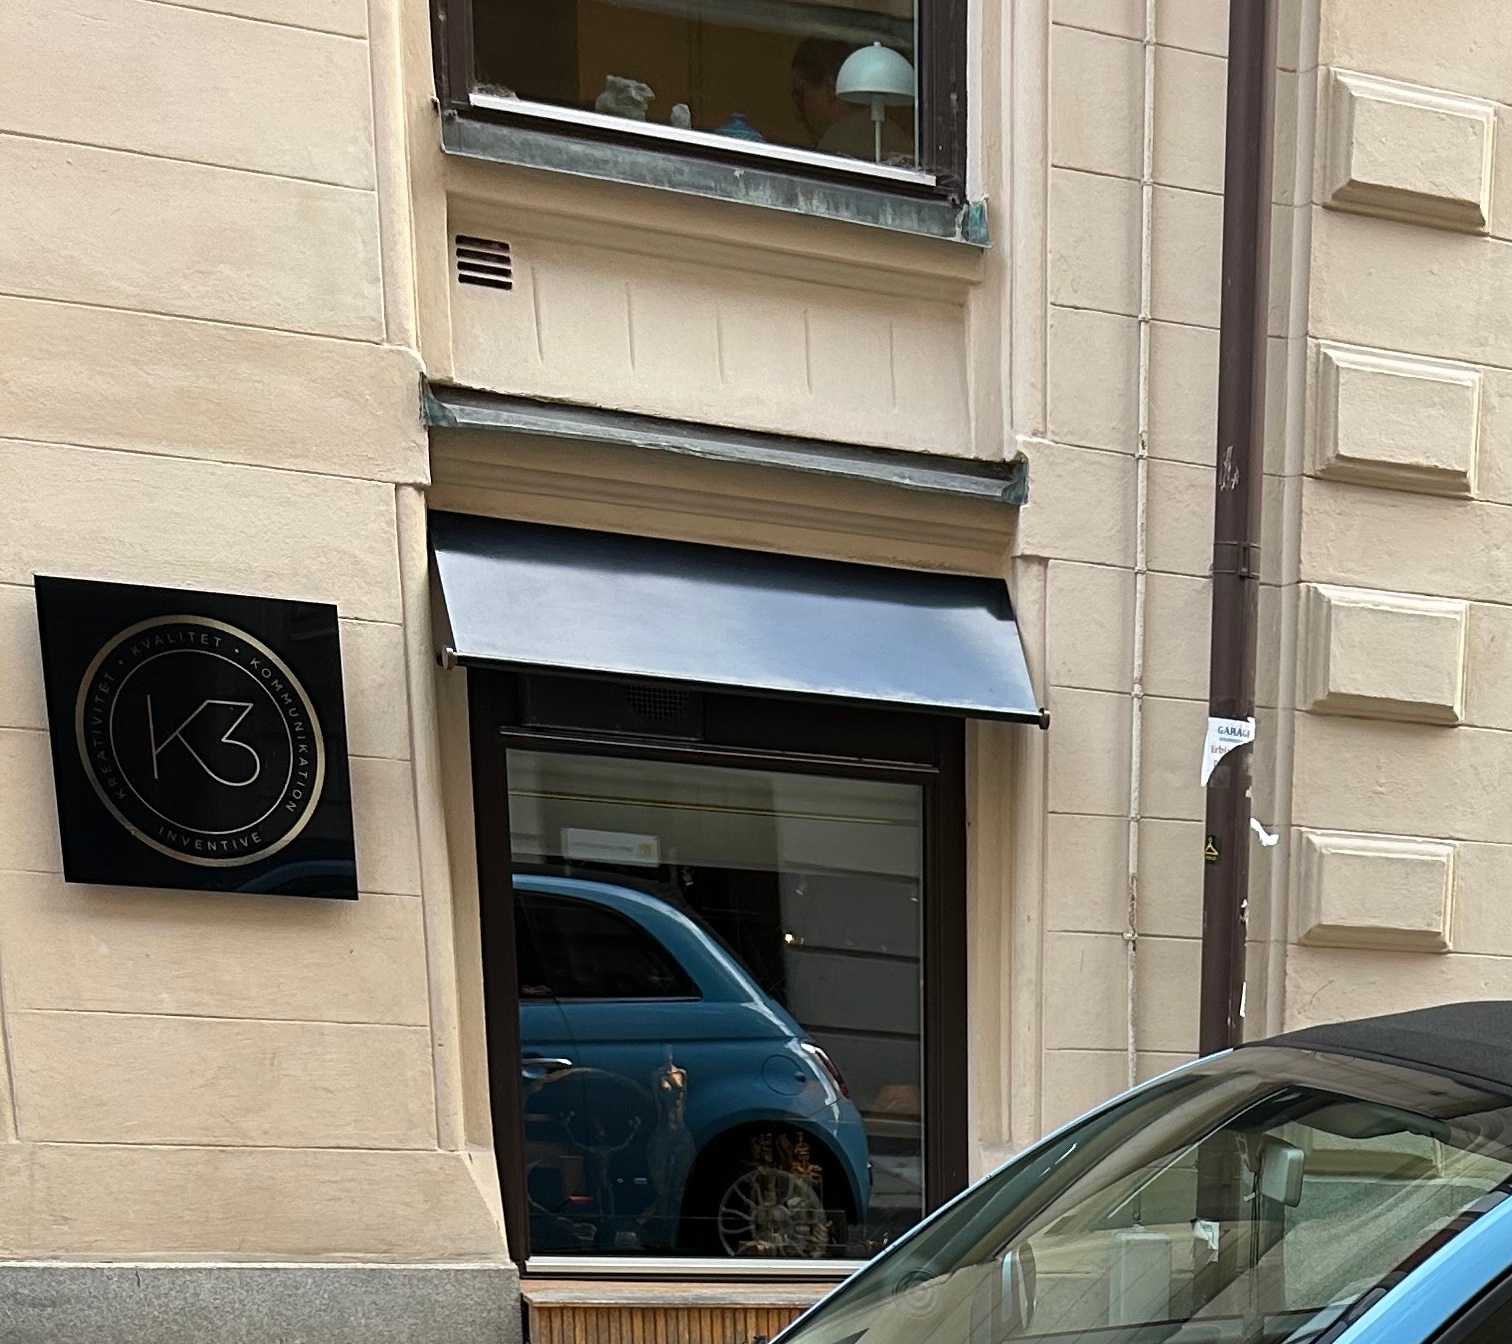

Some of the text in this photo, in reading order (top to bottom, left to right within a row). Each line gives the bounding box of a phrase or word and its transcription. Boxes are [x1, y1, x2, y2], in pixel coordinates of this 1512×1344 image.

[130, 630, 223, 657] KVALITET
[91, 671, 127, 800] KREATIVITET
[146, 693, 261, 787] K3
[249, 657, 310, 813] KOMMUNIKATION
[158, 825, 262, 852] INVENTIVE
